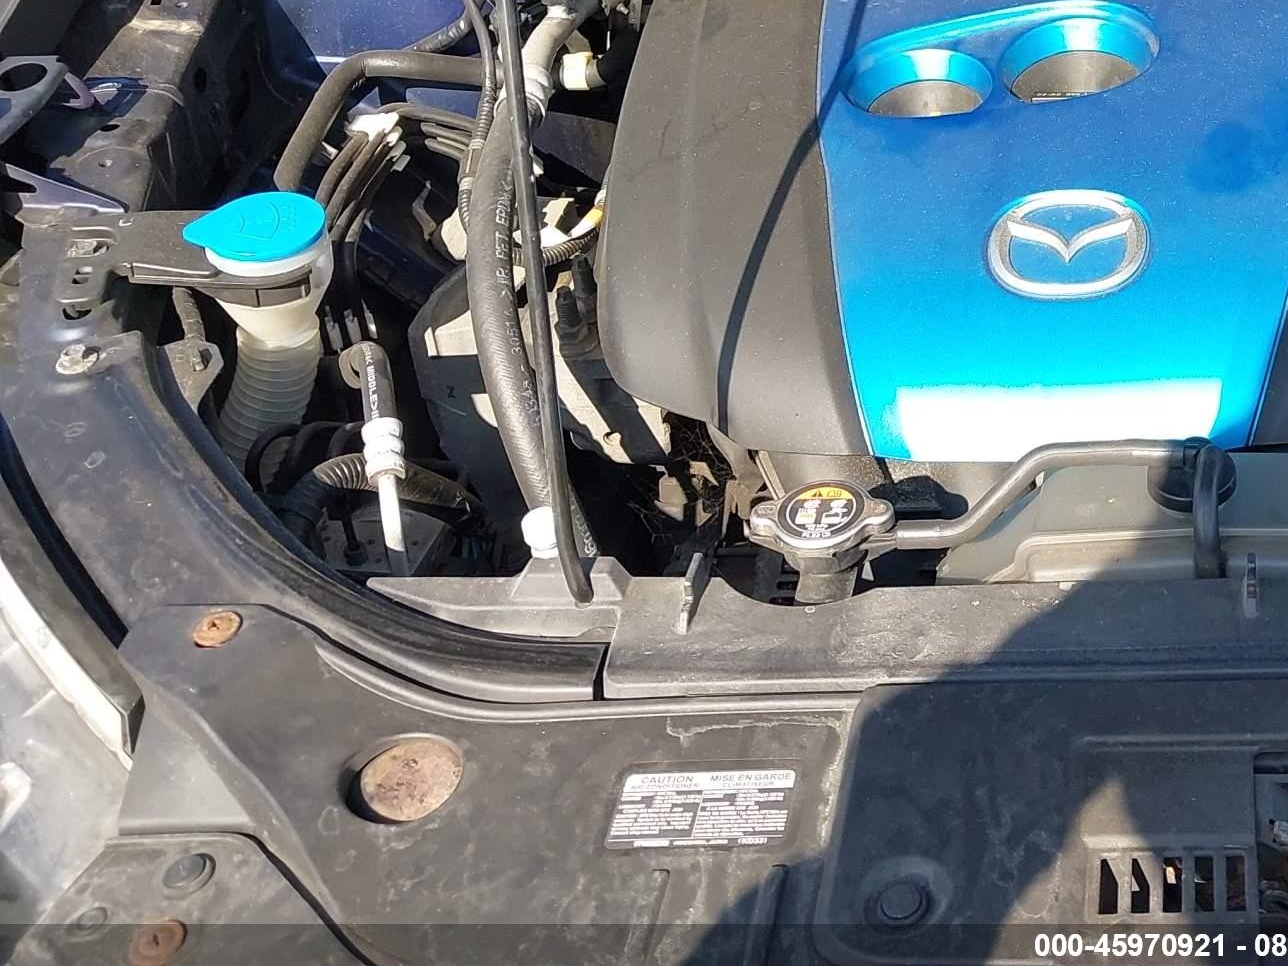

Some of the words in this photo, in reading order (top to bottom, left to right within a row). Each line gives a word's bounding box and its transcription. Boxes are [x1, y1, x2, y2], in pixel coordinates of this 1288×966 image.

[641, 775, 694, 784] CAUTION
[710, 774, 736, 782] MISE
[738, 773, 752, 781] EN
[754, 772, 792, 781] GARDE
